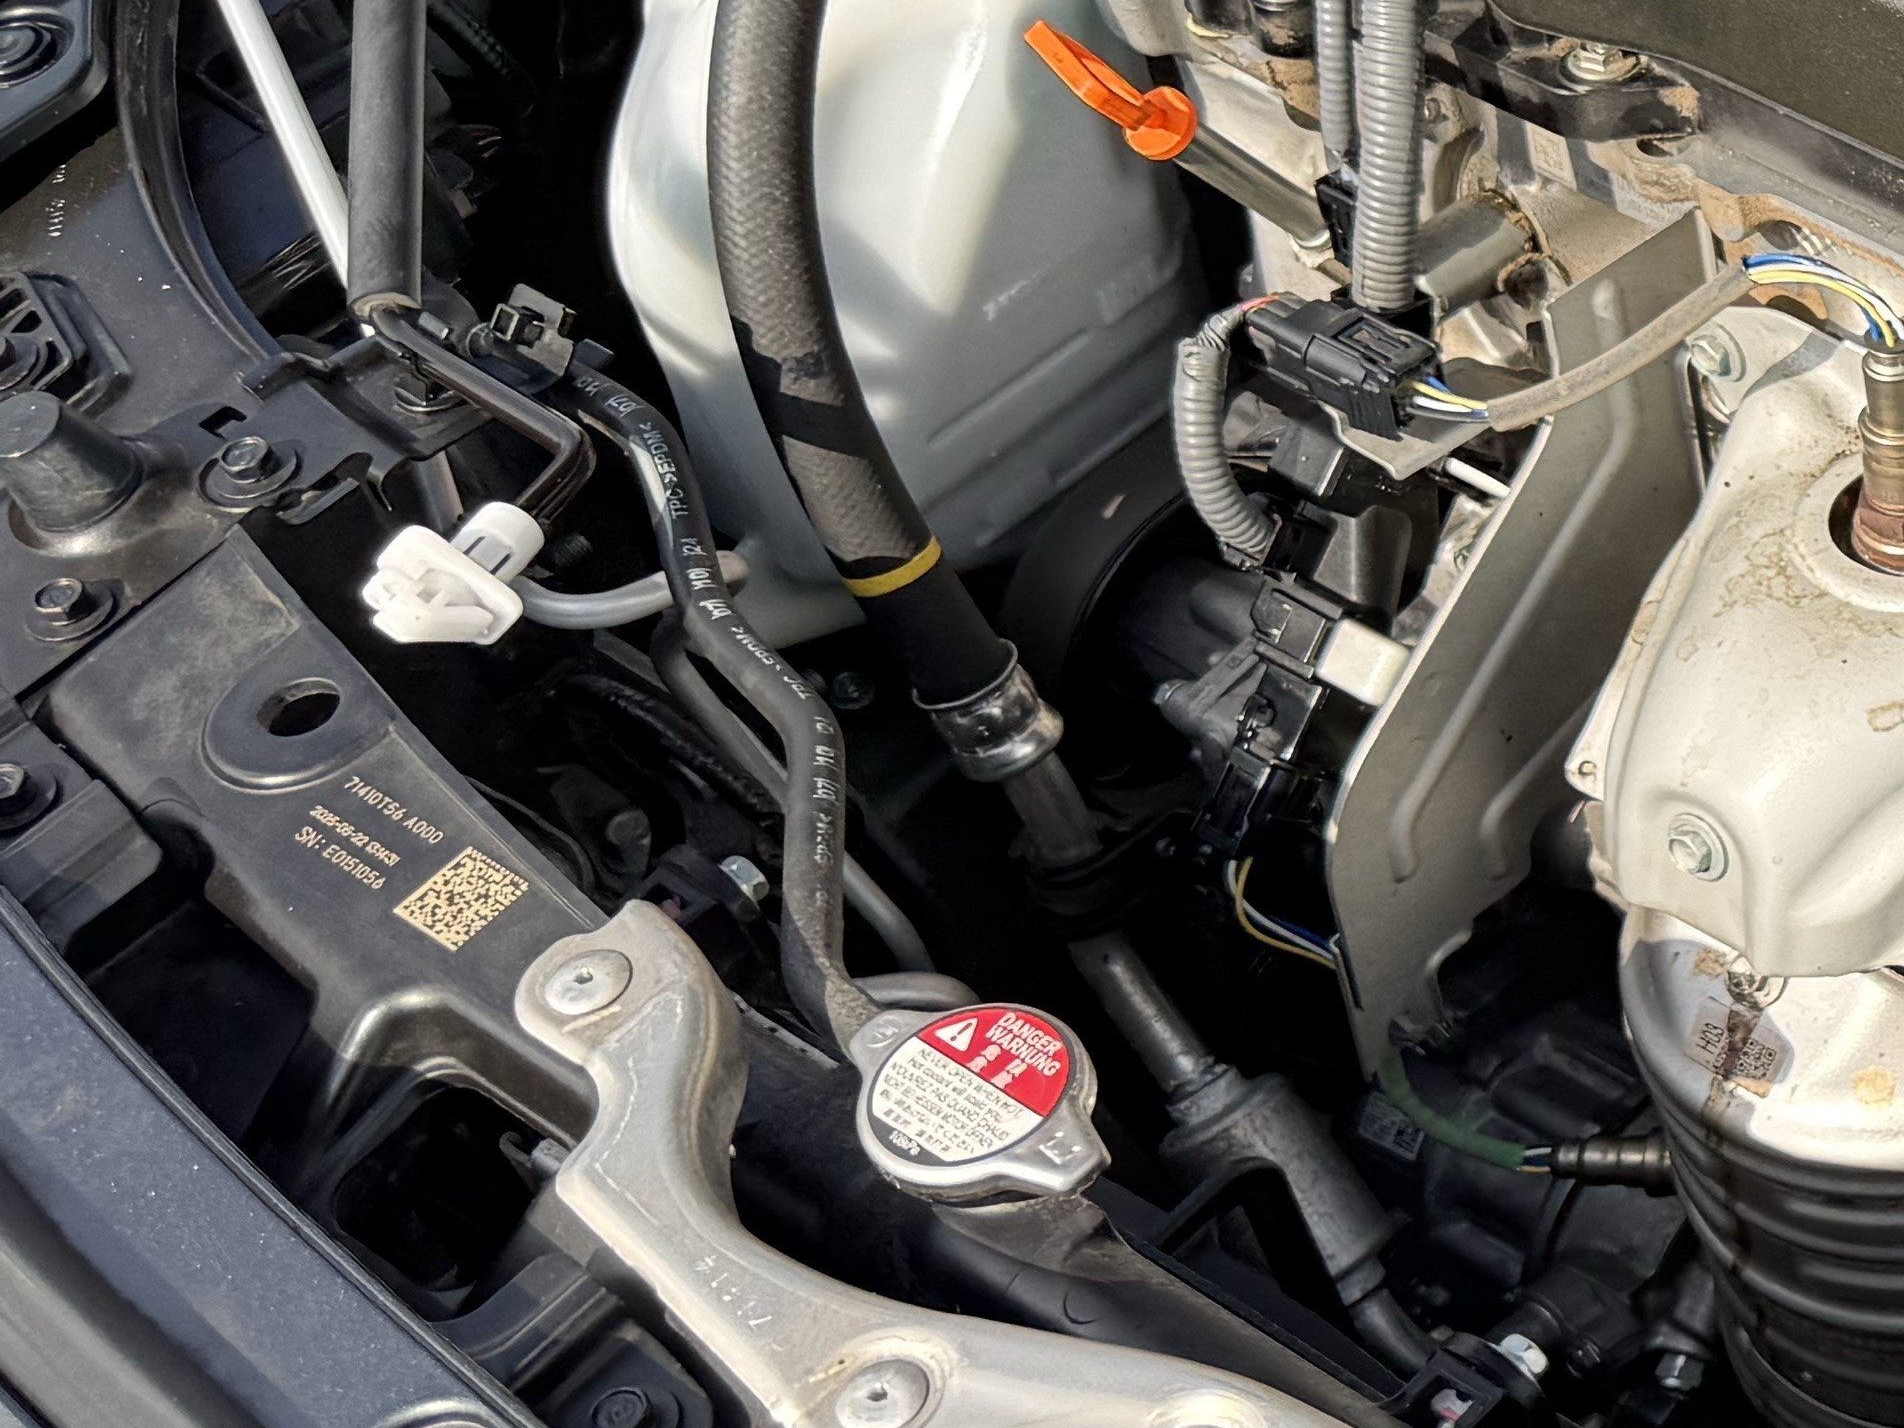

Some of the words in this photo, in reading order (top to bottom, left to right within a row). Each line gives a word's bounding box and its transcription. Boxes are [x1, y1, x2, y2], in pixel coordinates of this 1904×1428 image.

[344, 776, 408, 820] 71410T56
[403, 816, 444, 844] A000
[295, 826, 326, 850] SN:
[322, 844, 386, 891] E0151056
[986, 1024, 1061, 1077] WARNUNG
[1000, 1013, 1063, 1056] DANGER
